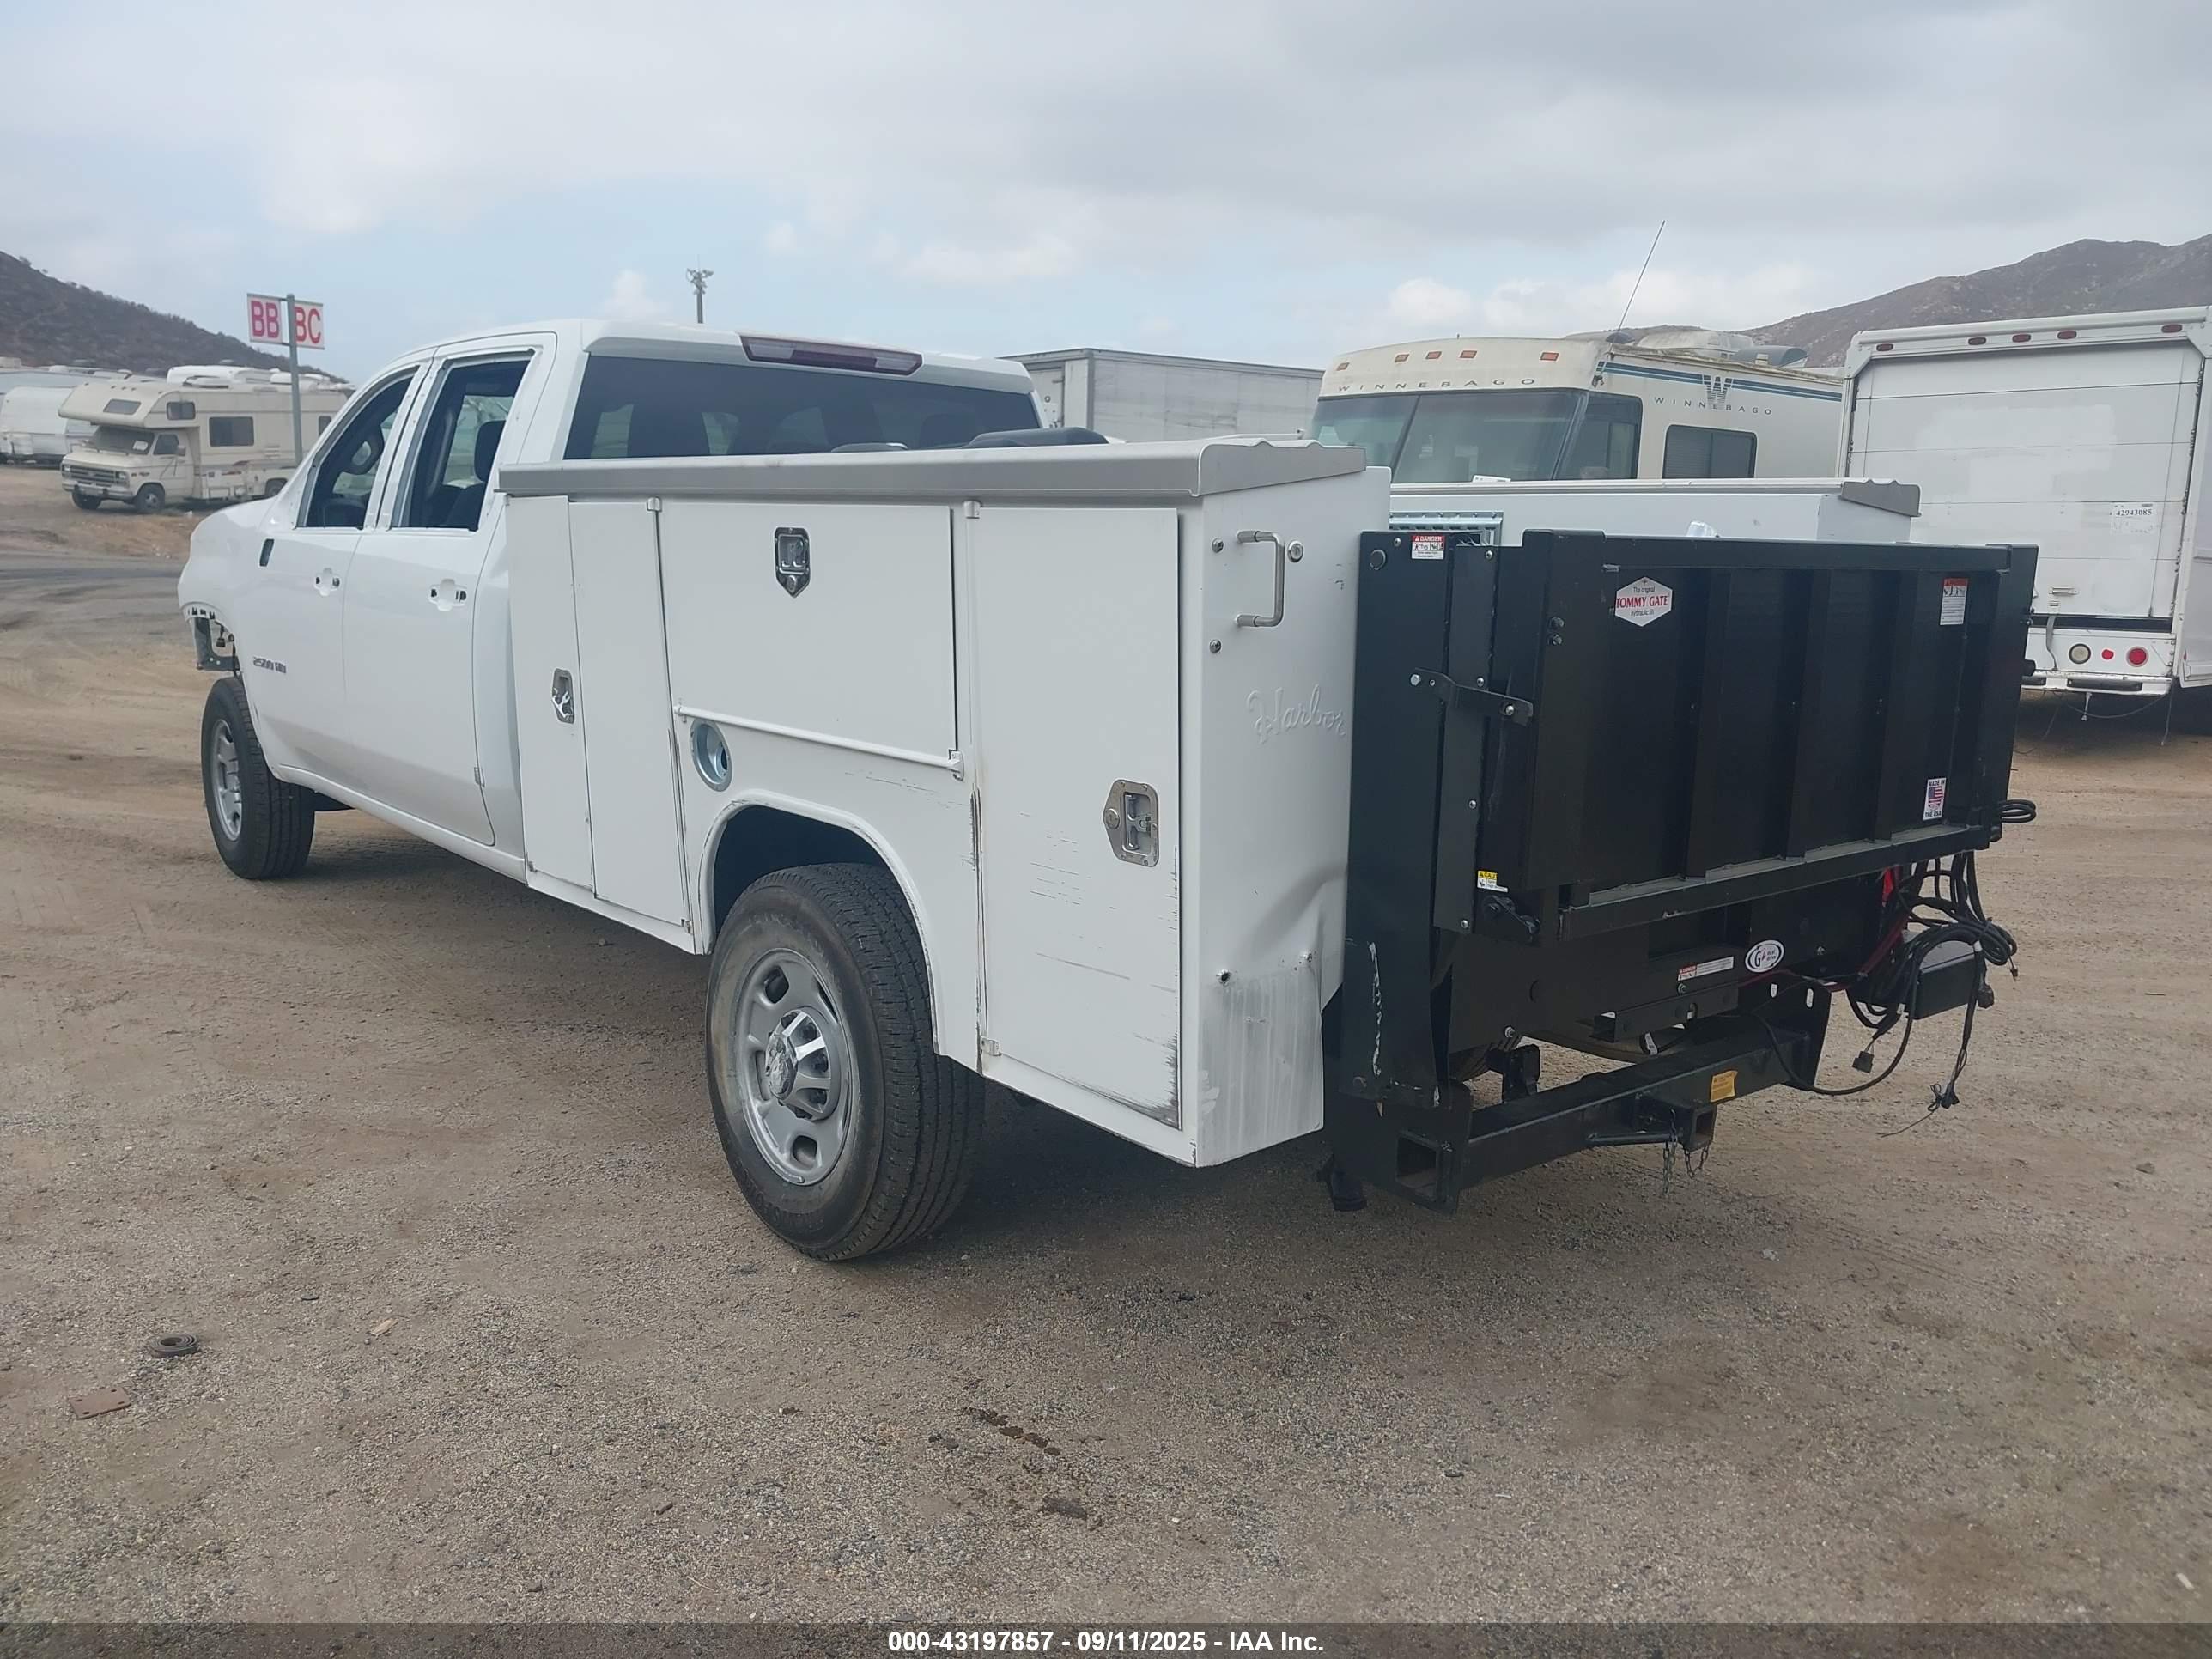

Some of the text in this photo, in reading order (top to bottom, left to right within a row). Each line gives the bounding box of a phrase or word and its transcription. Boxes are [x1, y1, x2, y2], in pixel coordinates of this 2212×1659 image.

[251, 300, 279, 338] BB
[295, 307, 321, 343] BC
[1338, 378, 1535, 392] WINNEBAGO
[1654, 397, 1772, 416] WINNEBAGO
[1616, 596, 1668, 608] TOMMY GATE
